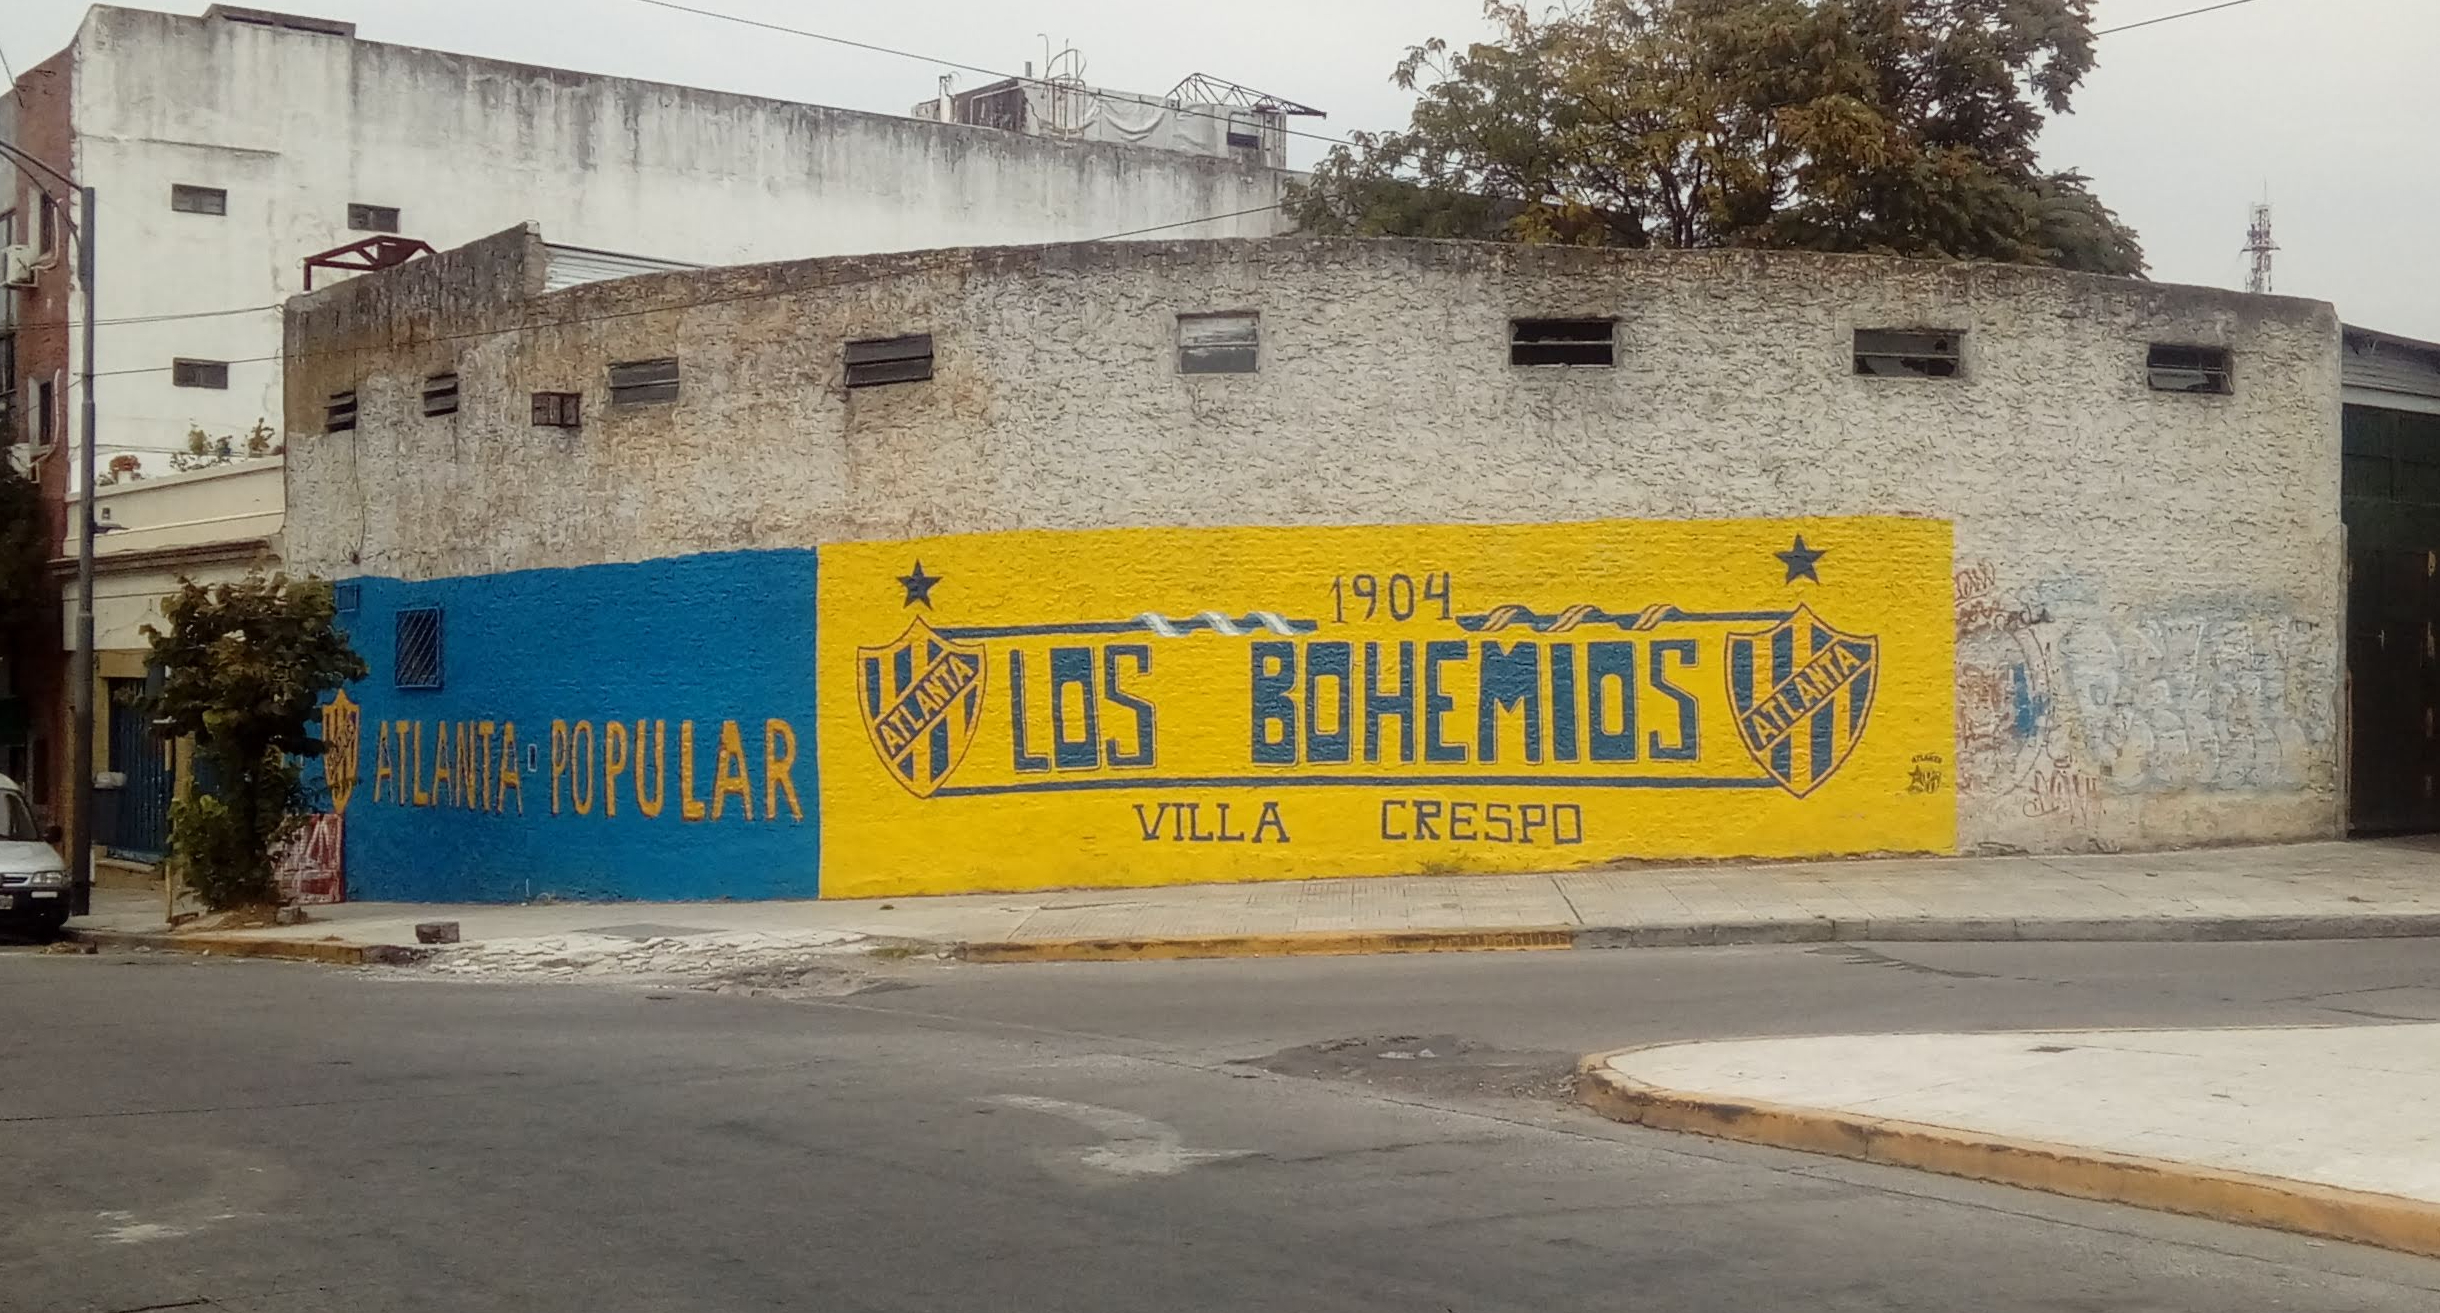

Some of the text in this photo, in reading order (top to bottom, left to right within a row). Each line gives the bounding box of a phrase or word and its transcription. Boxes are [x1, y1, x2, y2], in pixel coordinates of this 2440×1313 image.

[1328, 571, 1453, 624] 1904
[880, 655, 974, 756] ATLANTA
[1010, 640, 1700, 773] LOS BOHEMIOS
[1752, 643, 1861, 746] ATLANTA
[373, 720, 523, 816] ATLANTA
[550, 718, 804, 821] POPULAR
[1132, 800, 1583, 845] VILLA CRESPO
